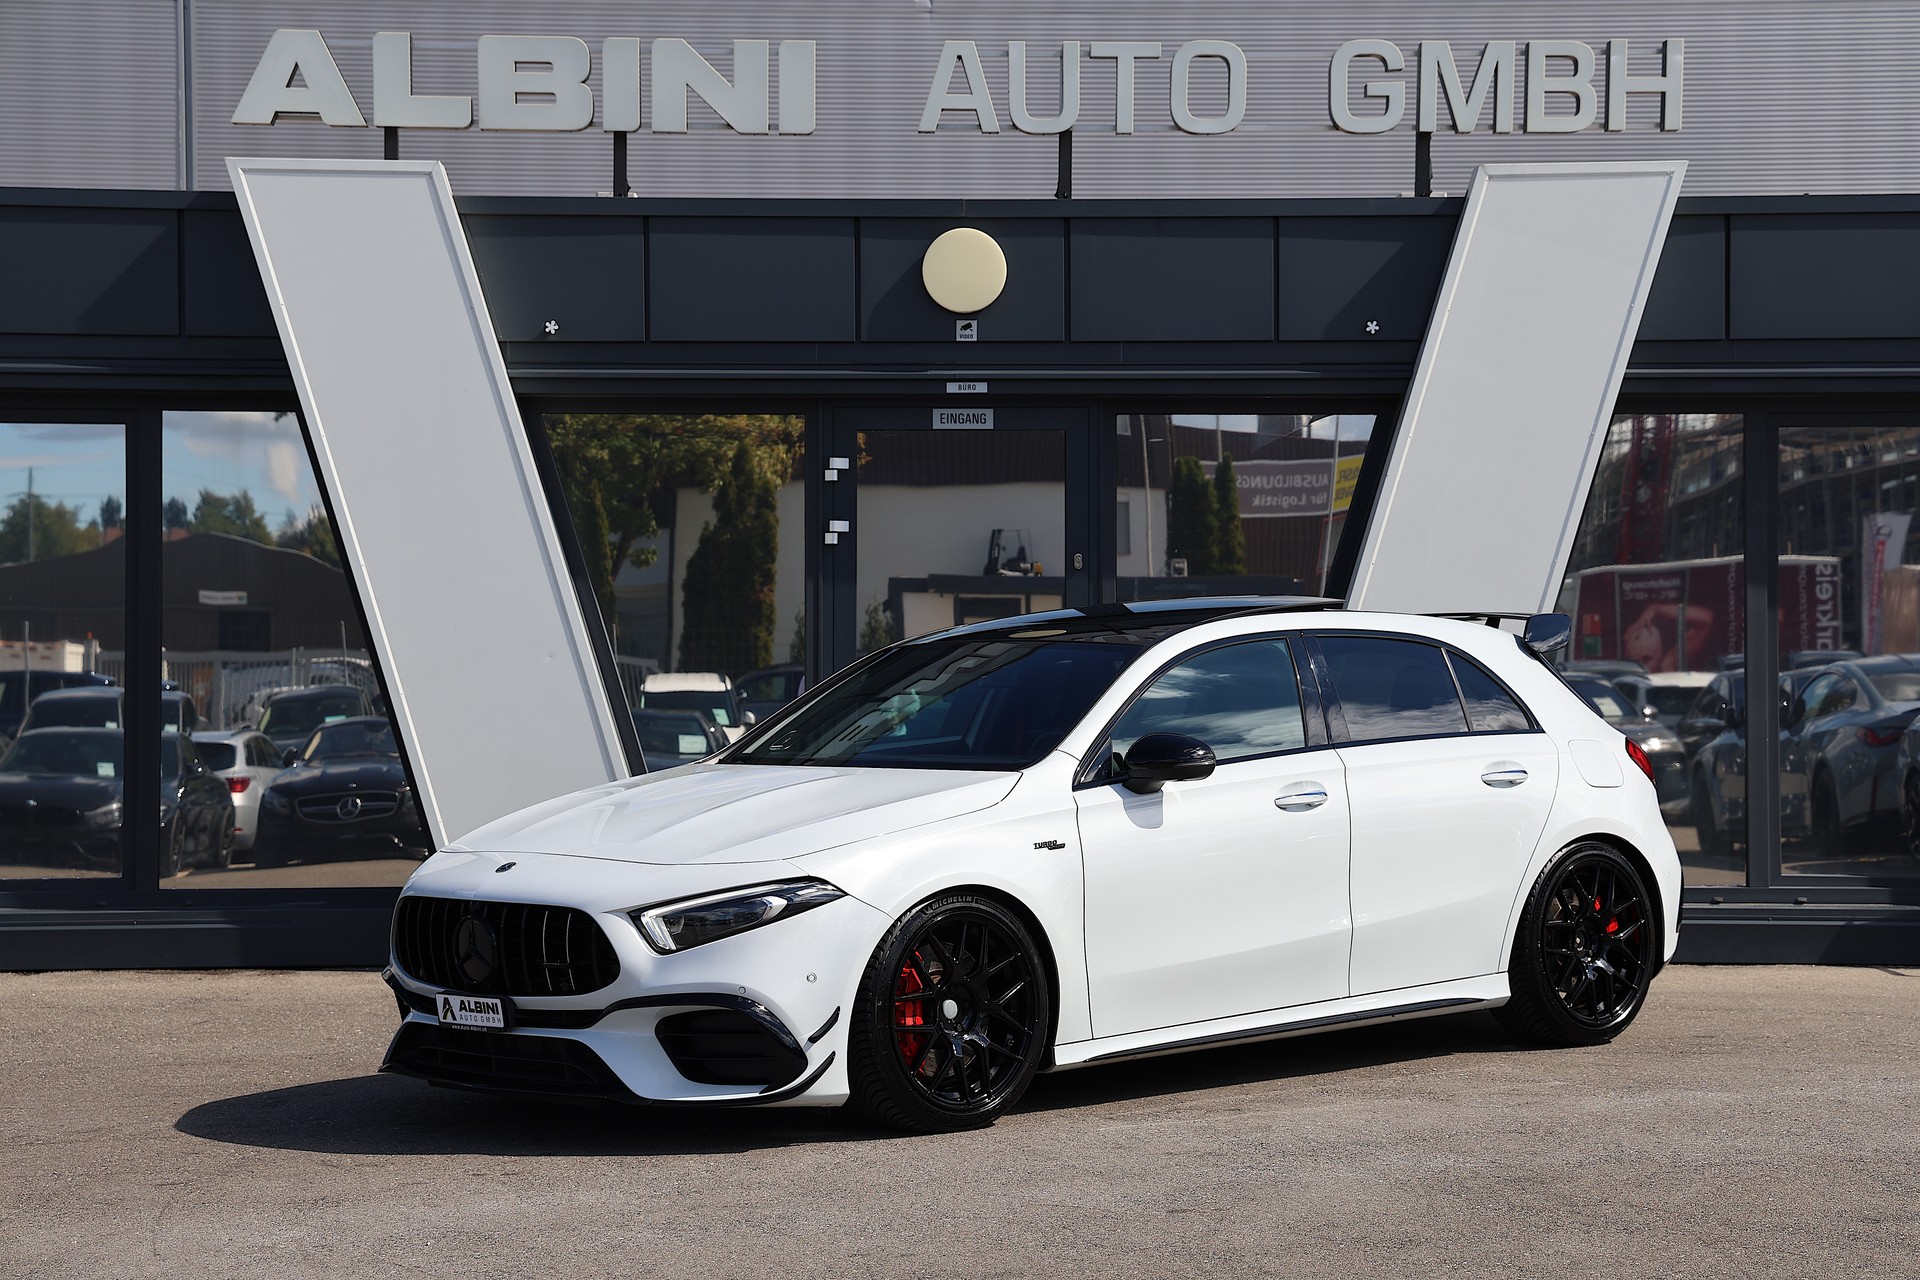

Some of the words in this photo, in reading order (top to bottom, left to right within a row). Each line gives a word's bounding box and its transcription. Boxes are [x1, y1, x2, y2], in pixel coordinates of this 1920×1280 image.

[231, 29, 816, 135] ALBINI
[918, 40, 1247, 135] AUTO
[1328, 38, 1684, 134] GMBH
[957, 383, 977, 391] BÜRO
[940, 412, 987, 424] EINGANG
[1033, 840, 1057, 849] TURBO
[932, 895, 973, 909] MICHELIN
[459, 999, 500, 1015] ALBINI
[459, 1014, 478, 1022] AUTO
[481, 1015, 502, 1024] GMBH
